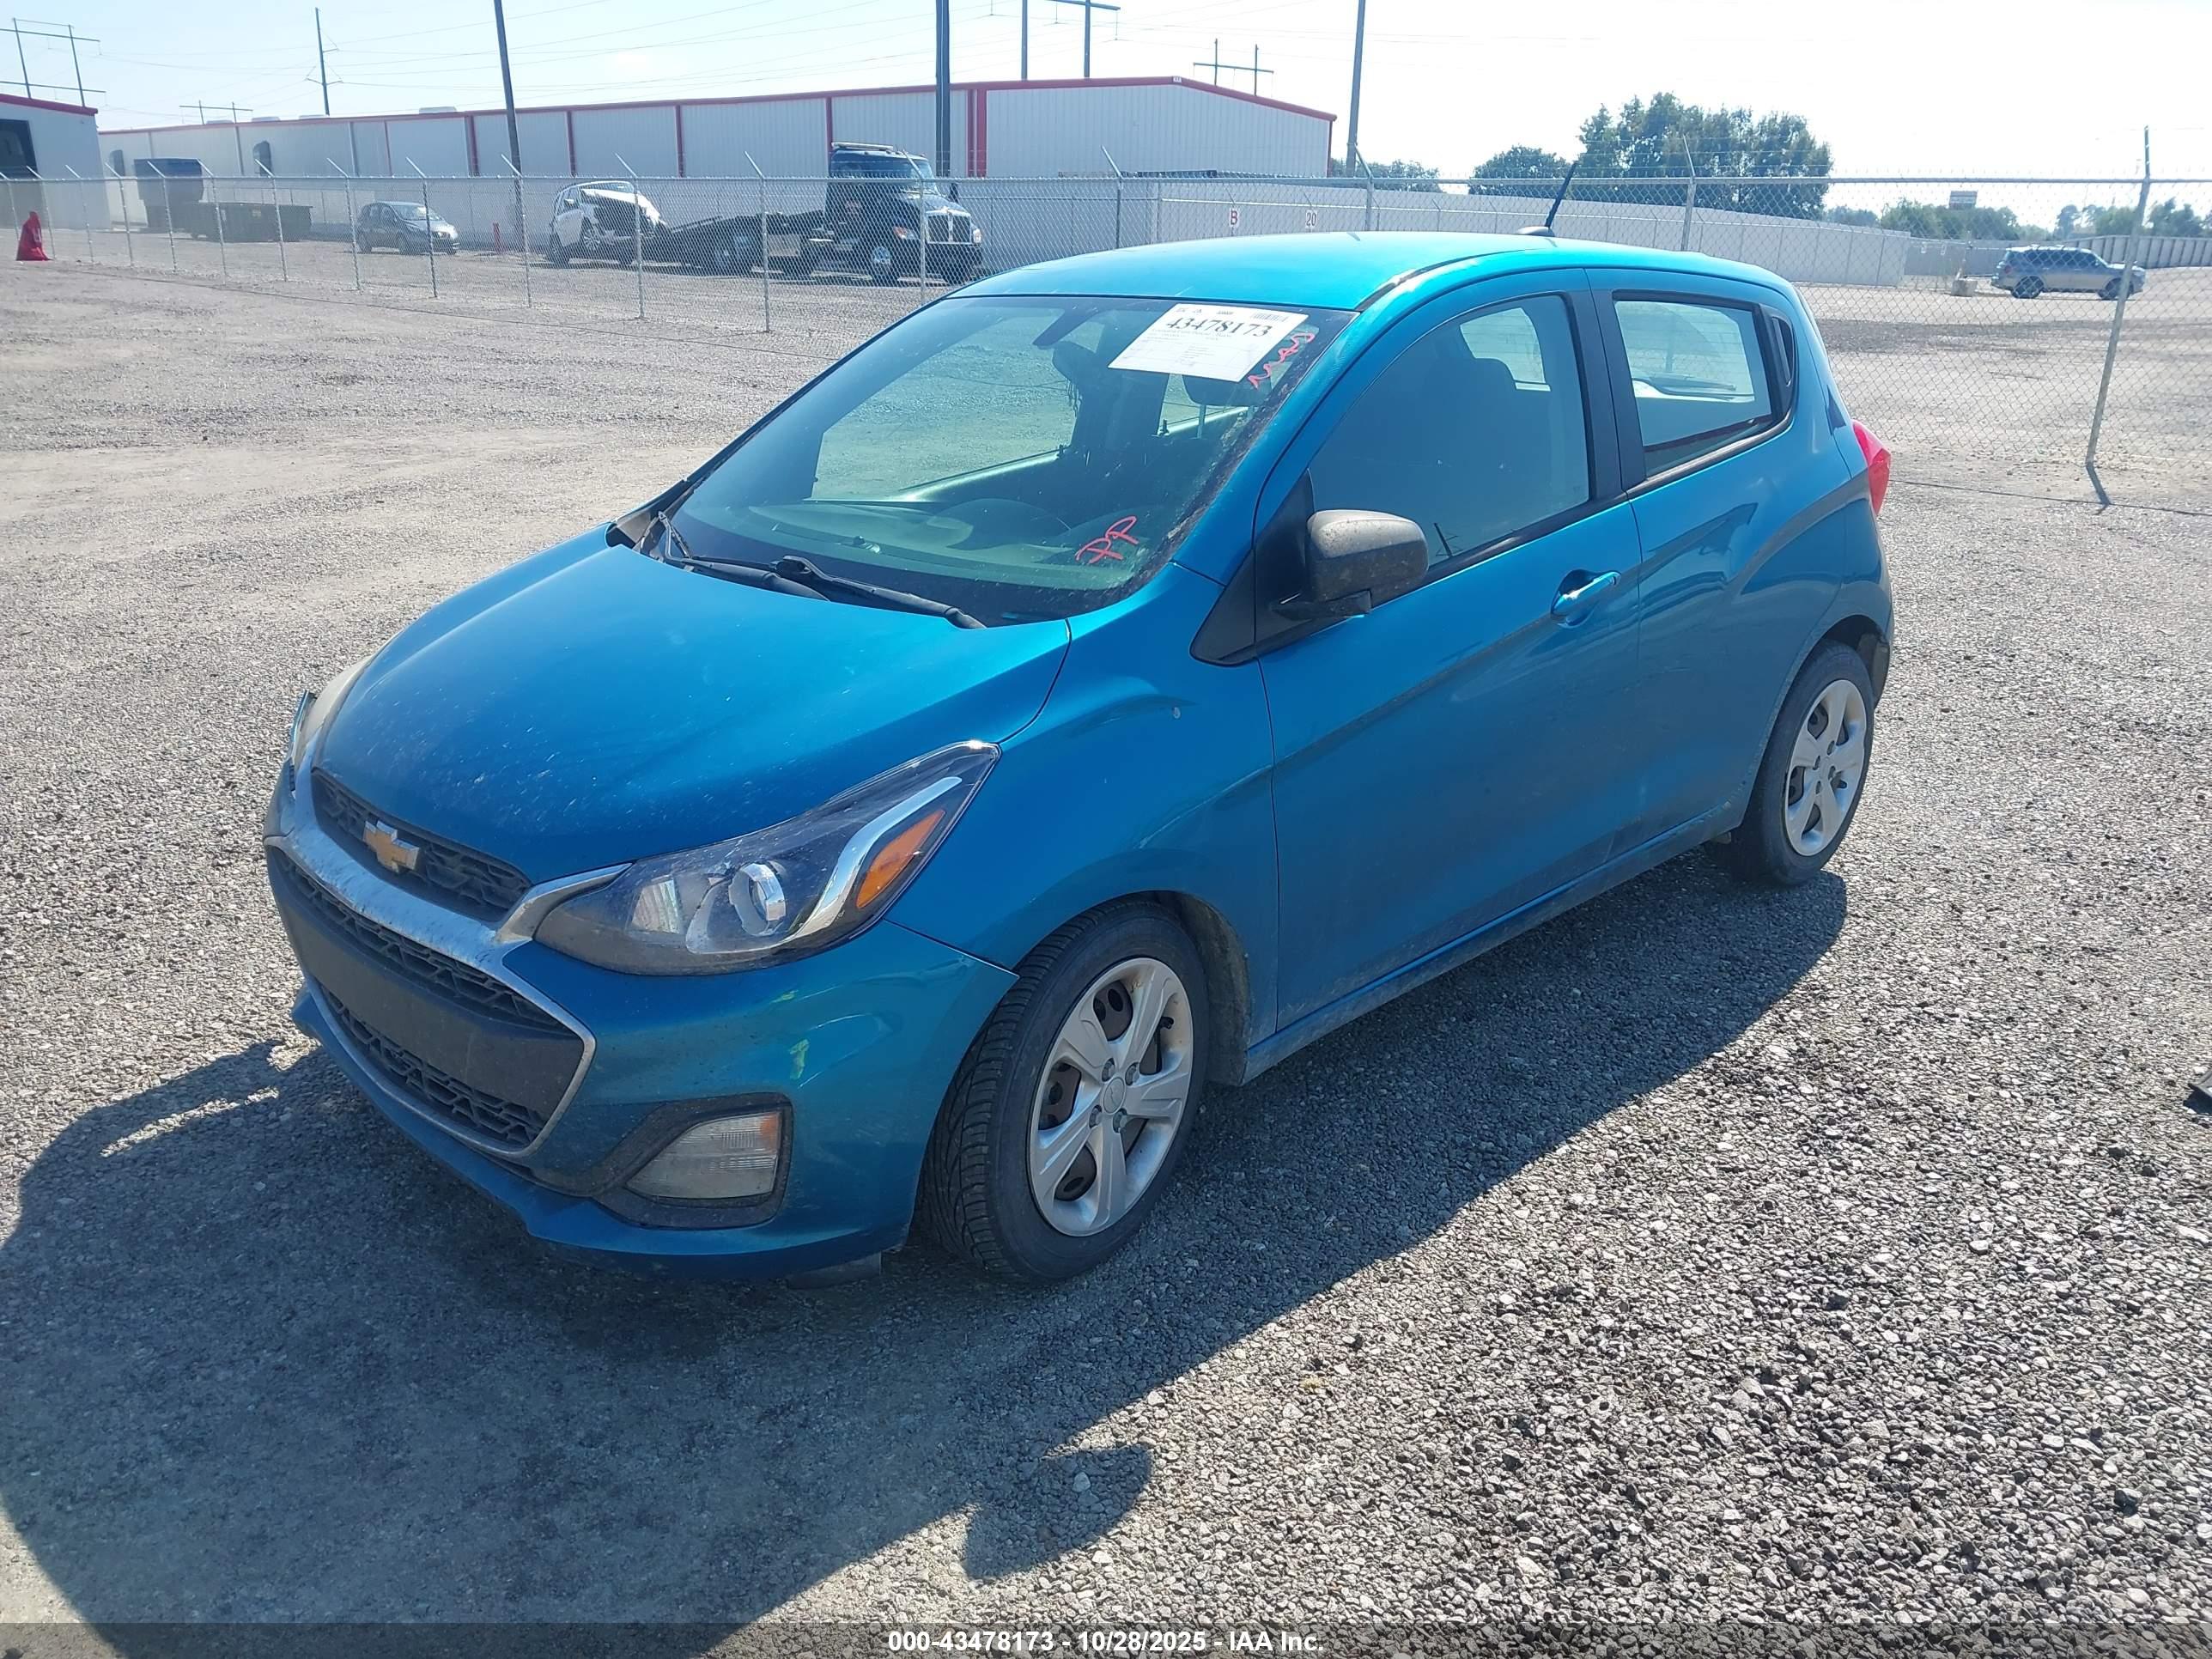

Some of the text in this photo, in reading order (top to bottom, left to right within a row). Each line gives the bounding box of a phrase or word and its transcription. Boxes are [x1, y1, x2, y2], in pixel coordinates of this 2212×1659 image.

[1231, 210, 1237, 225] B
[1305, 212, 1316, 227] 20
[1166, 317, 1272, 337] 43478173
